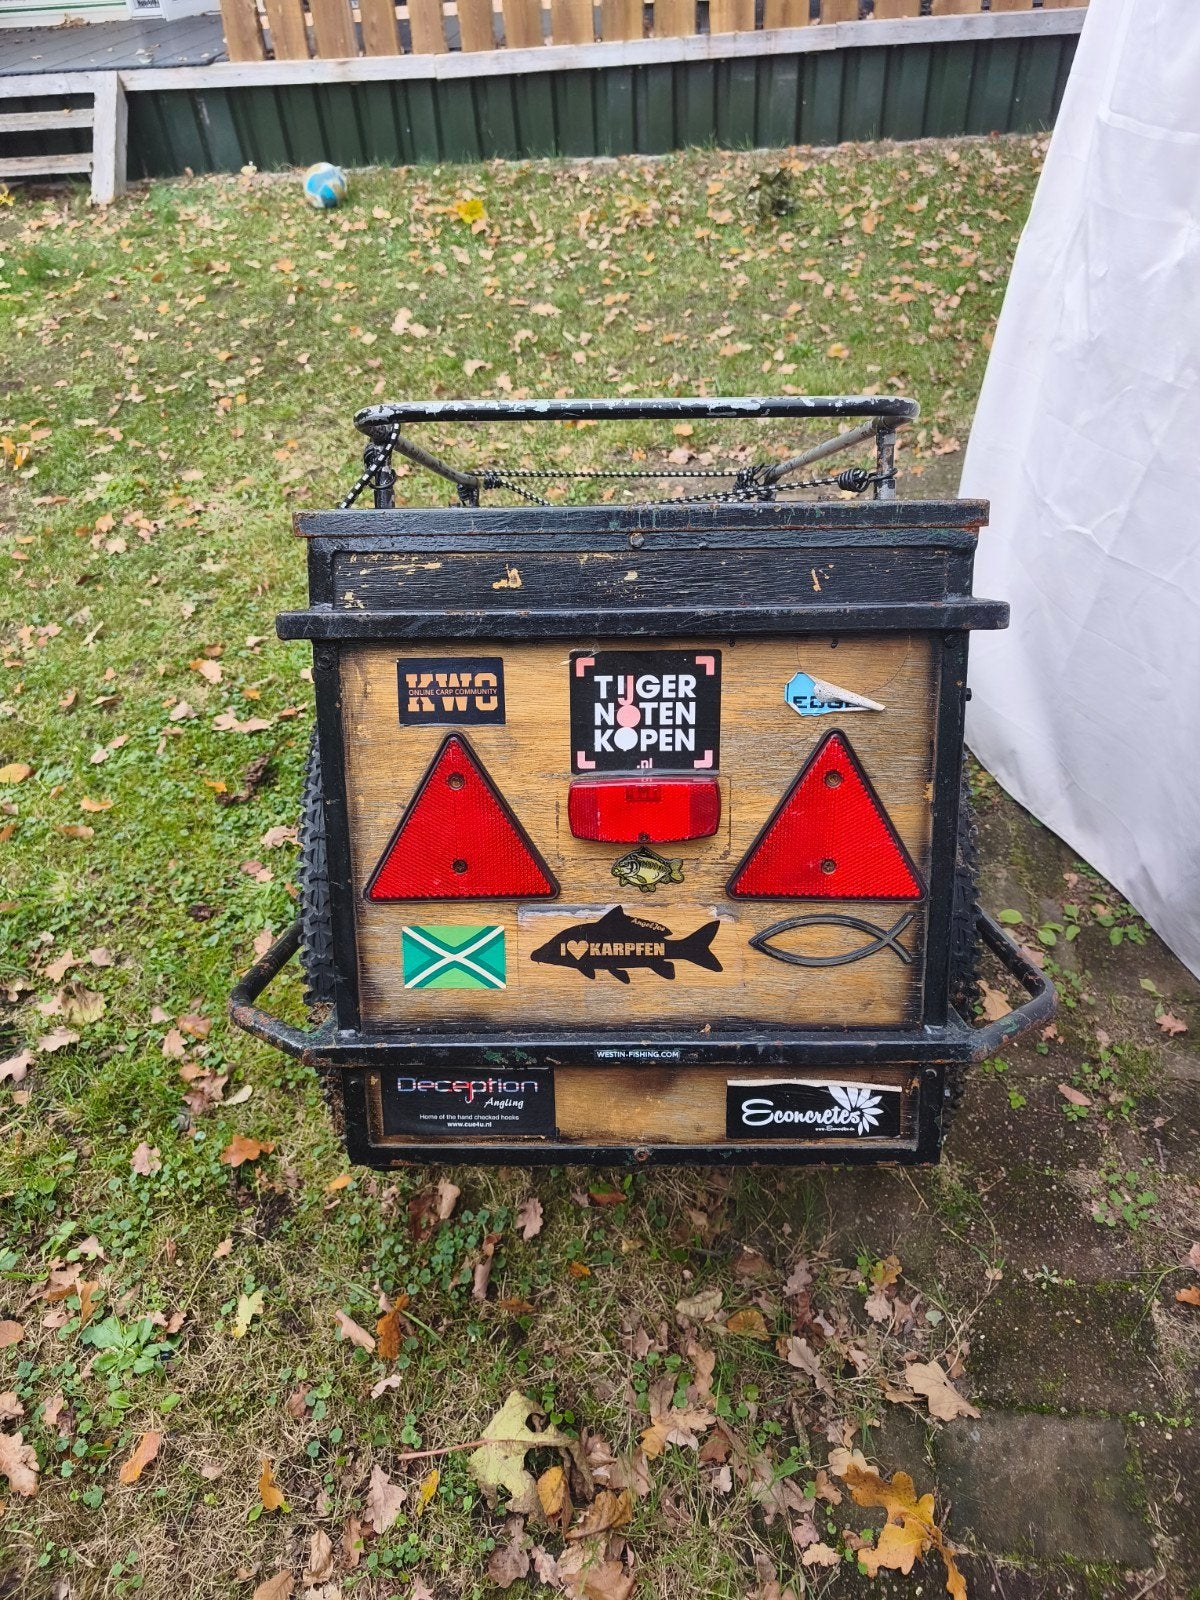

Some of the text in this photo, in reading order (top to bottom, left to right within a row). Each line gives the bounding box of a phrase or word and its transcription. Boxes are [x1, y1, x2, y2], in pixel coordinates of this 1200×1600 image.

[435, 688, 453, 696] CARP
[594, 702, 697, 728] NOTEN
[594, 727, 696, 752] KOPEN
[636, 757, 654, 769] .nl
[560, 942, 666, 957] I KARPFEN
[397, 1077, 539, 1104] Deception
[483, 1096, 525, 1110] Angling
[741, 1098, 862, 1127] Econcretes
